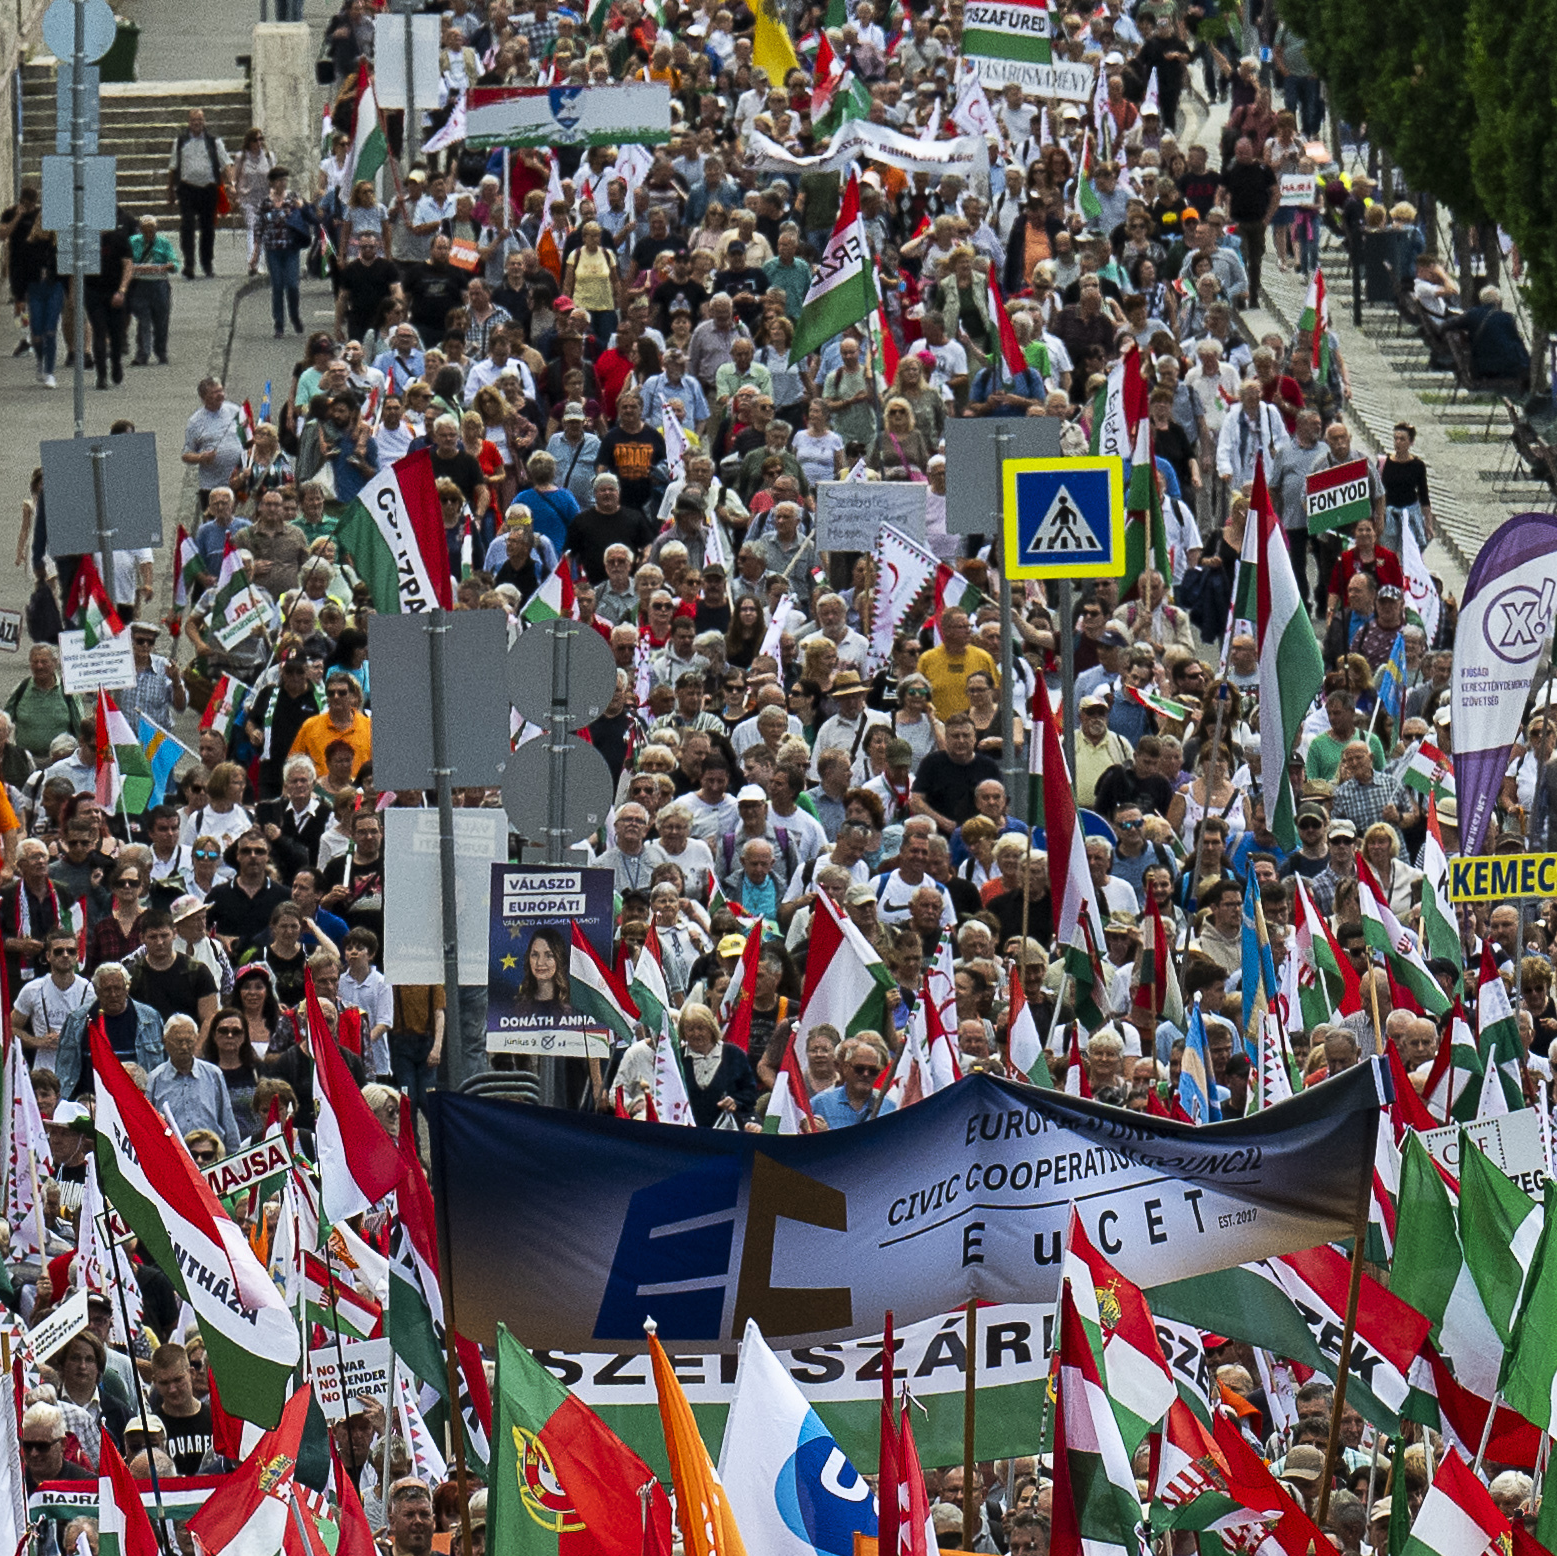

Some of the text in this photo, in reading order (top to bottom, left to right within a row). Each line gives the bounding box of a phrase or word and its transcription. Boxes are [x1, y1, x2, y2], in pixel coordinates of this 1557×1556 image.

[509, 877, 576, 891] VÁLASZD
[508, 897, 580, 913] EURÓPÁT!
[500, 1014, 597, 1028] DONÁTH ANNA
[887, 1173, 962, 1227] CIVIC
[965, 1145, 1142, 1193] COOPERATION
[316, 1358, 366, 1378] NO WAR
[318, 1369, 387, 1391] NO GENDER
[321, 1391, 341, 1403] NO
